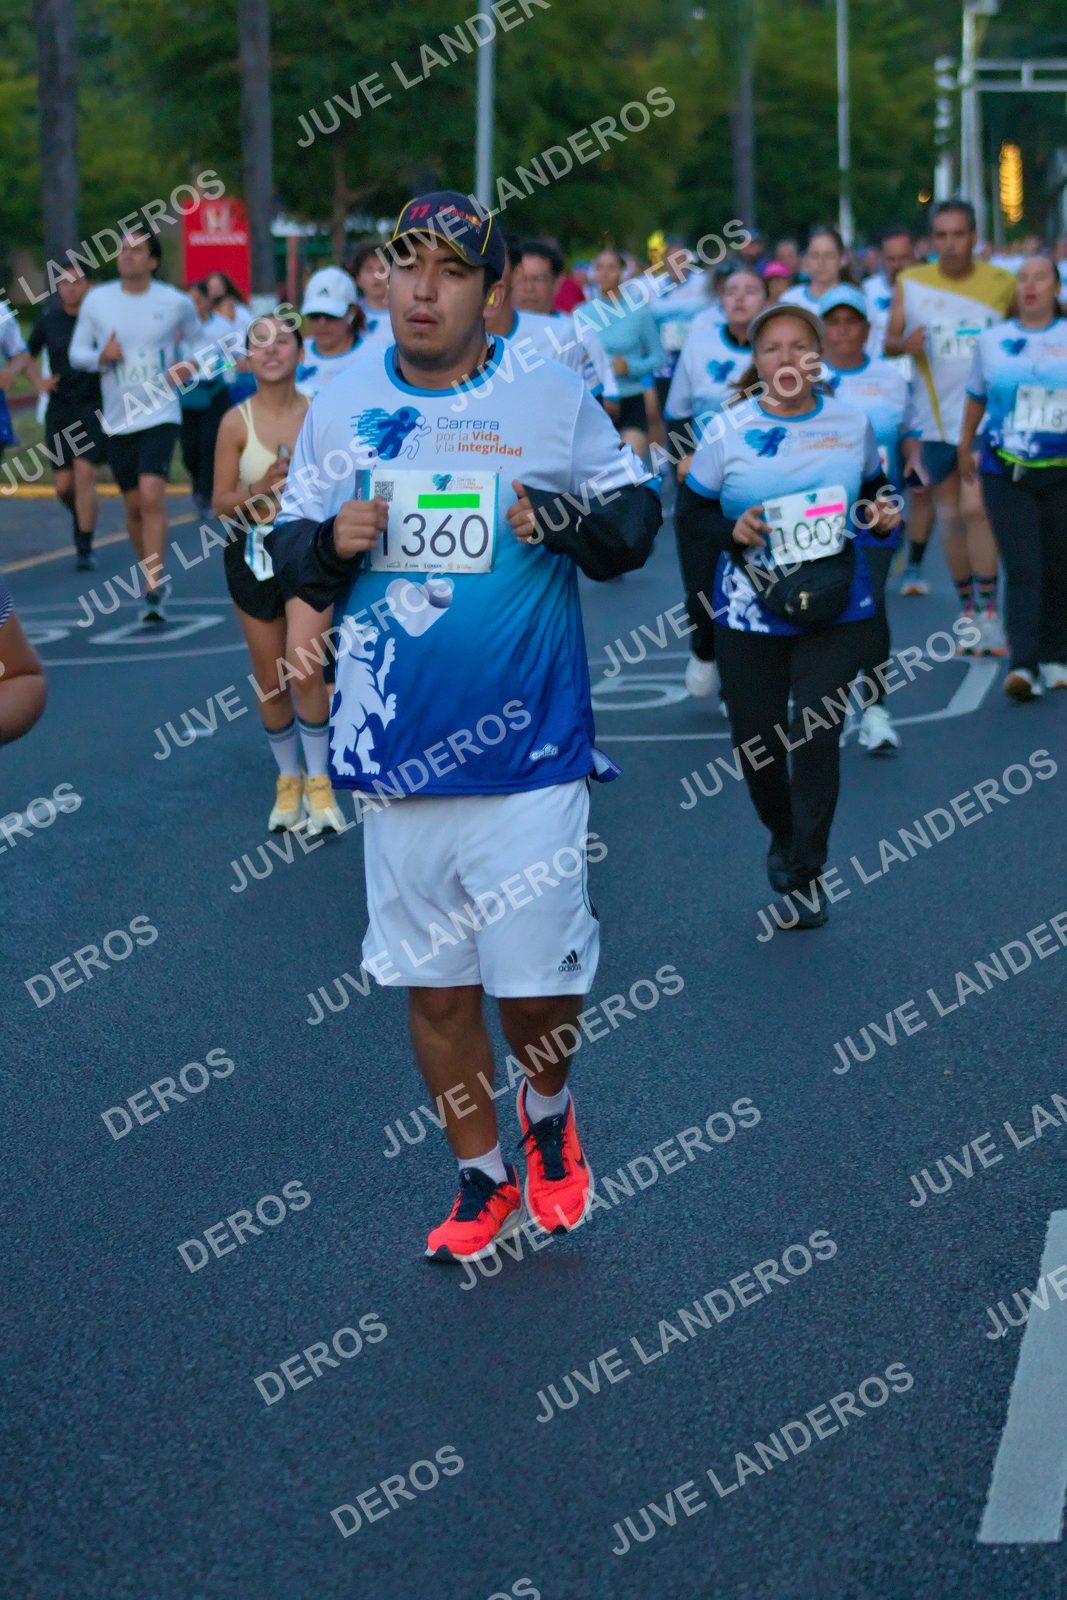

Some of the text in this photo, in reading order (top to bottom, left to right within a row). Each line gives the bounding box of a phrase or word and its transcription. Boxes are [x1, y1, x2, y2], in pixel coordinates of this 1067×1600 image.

[409, 203, 431, 220] 11
[437, 417, 500, 430] Carrera
[436, 430, 500, 443] por la Vida
[444, 442, 455, 452] la
[457, 443, 523, 456] Integridad
[382, 513, 489, 559] 1360
